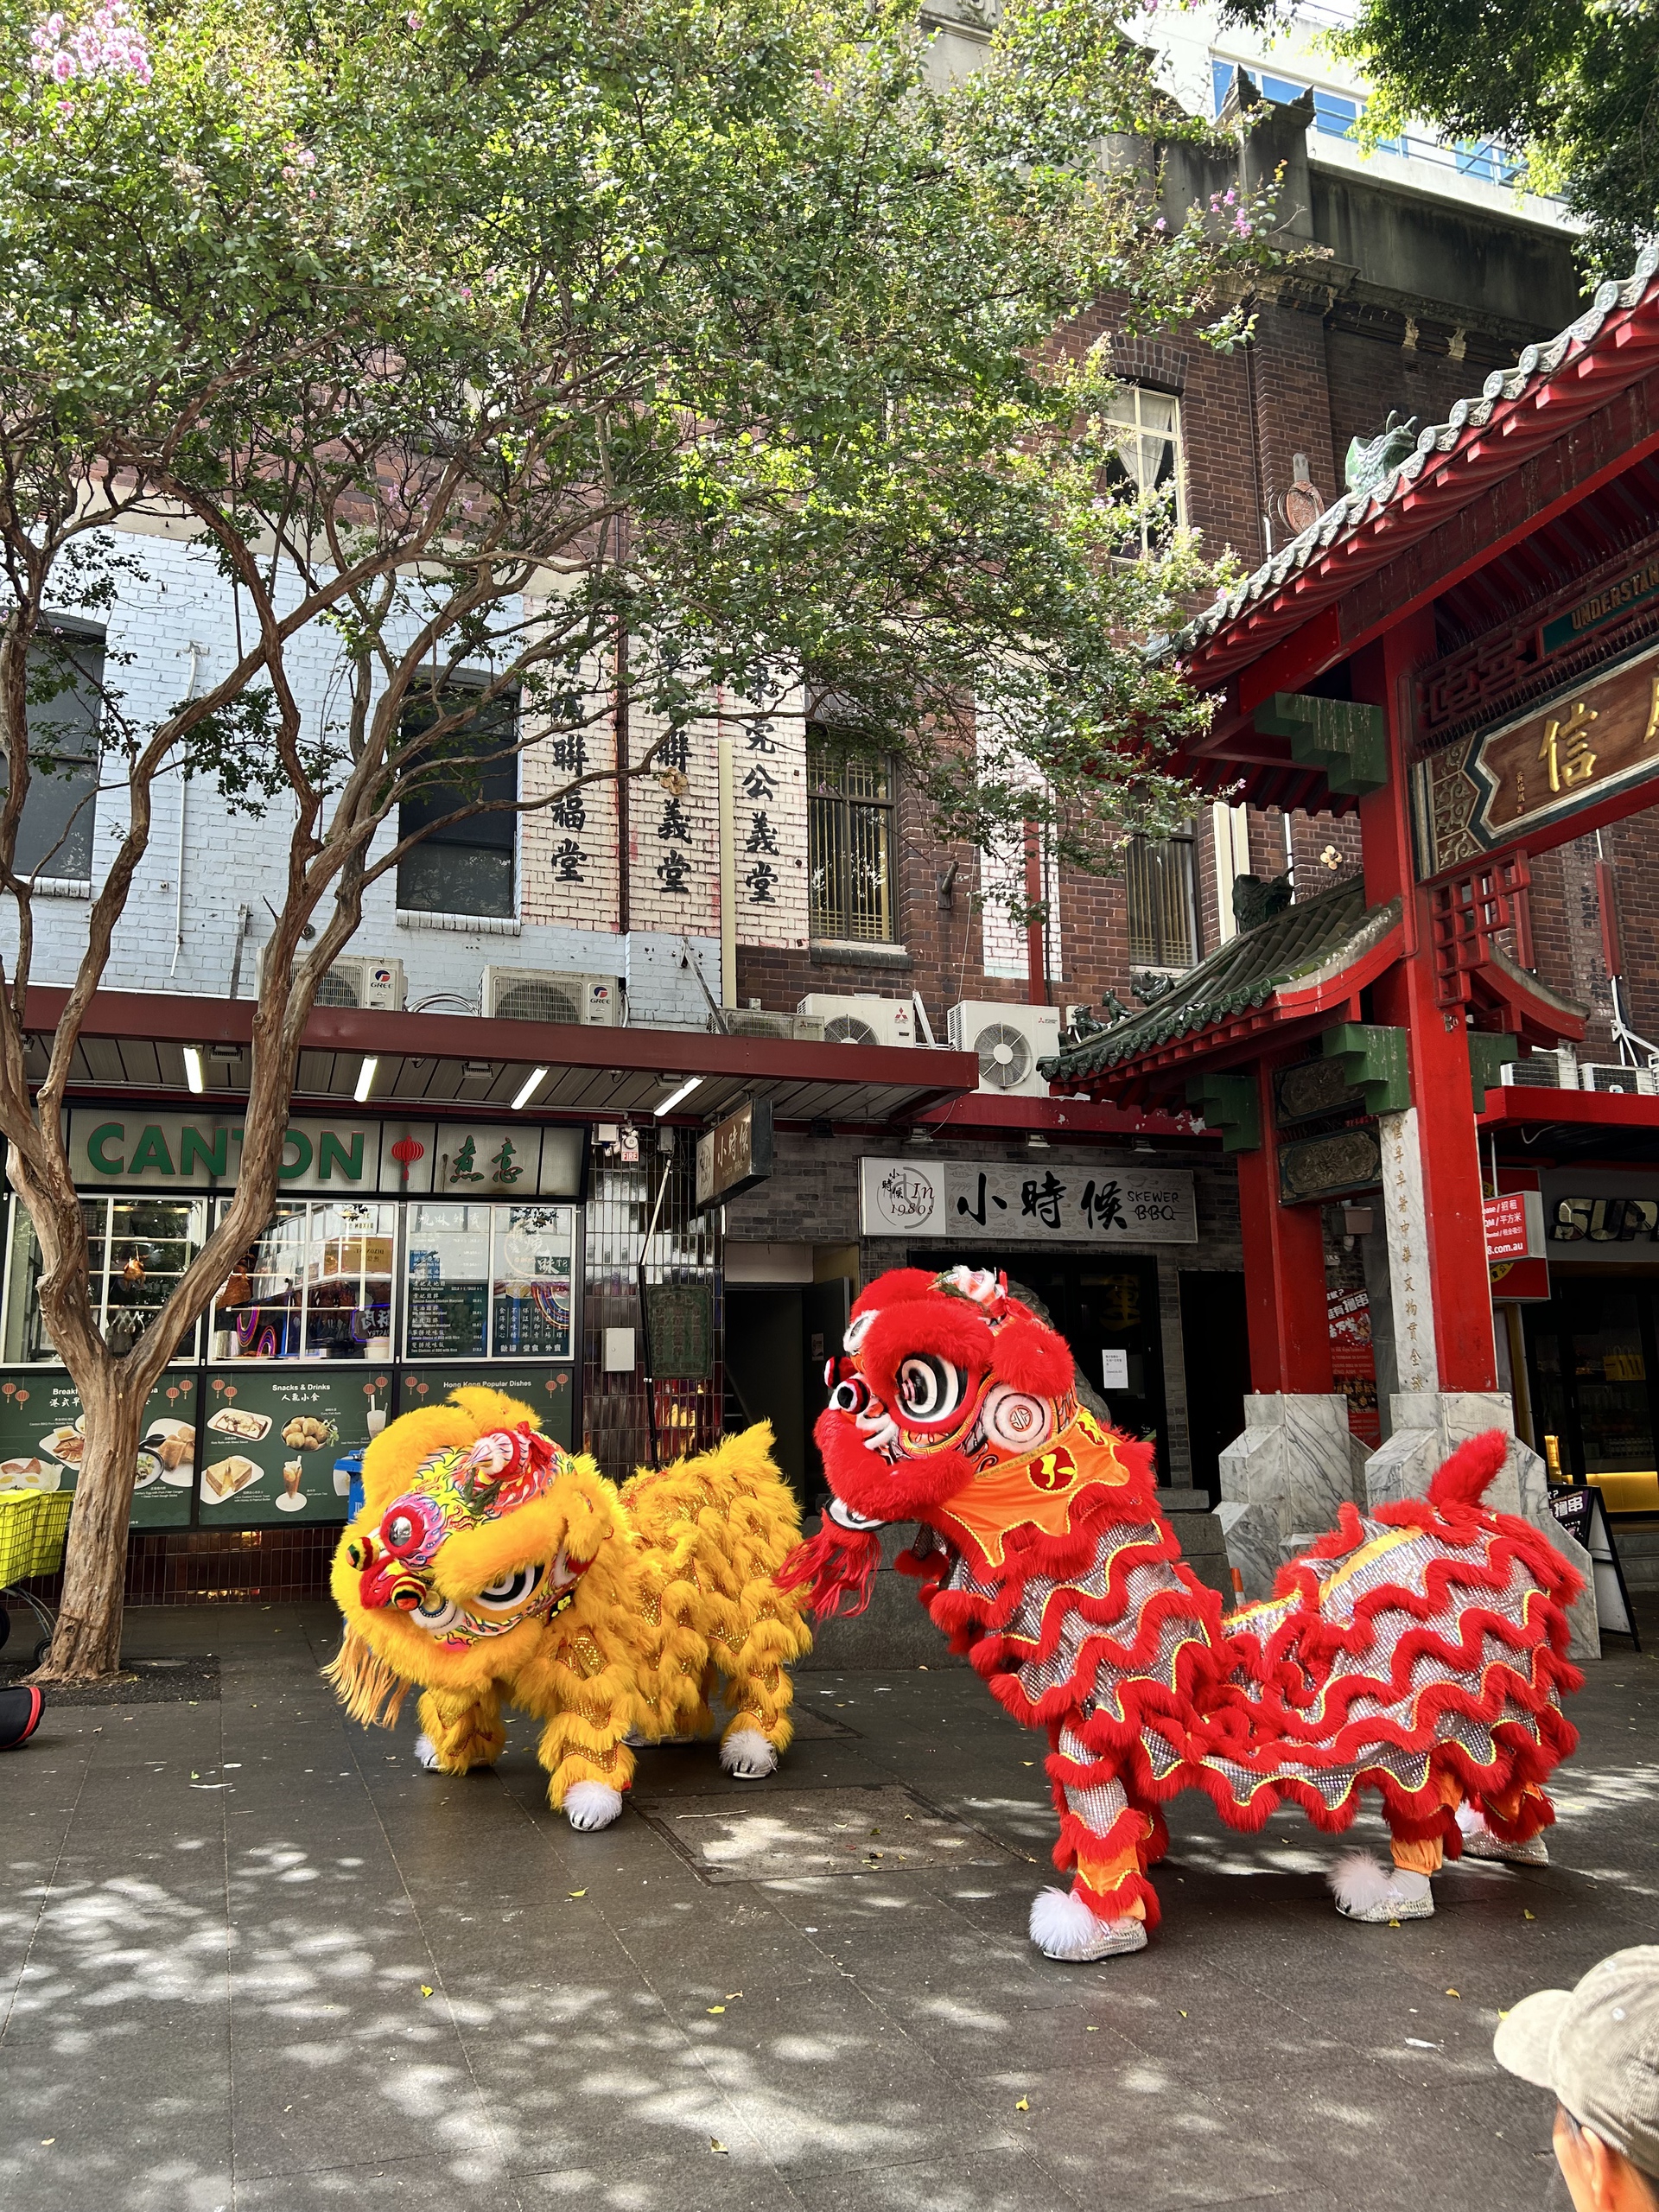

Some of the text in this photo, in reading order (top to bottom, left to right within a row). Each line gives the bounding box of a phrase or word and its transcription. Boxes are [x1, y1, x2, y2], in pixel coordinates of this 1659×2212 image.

[657, 645, 693, 894] 聯義堂
[87, 1122, 364, 1179] CANON
[718, 1123, 748, 1167] 小時候
[450, 1135, 523, 1184] 煮意
[623, 1152, 638, 1160] FIRE
[882, 1168, 903, 1199] 小時候
[912, 1183, 935, 1198] In
[957, 1171, 1128, 1230] 小時候
[1127, 1191, 1179, 1204] SKEWER
[891, 1203, 933, 1216] 1980s
[1135, 1205, 1177, 1221] BBQ
[1484, 1218, 1495, 1227] QM
[1500, 1212, 1522, 1224] 平方米
[1554, 1198, 1659, 1241] SUP
[1487, 1243, 1523, 1255] 8.com.au
[49, 1396, 80, 1408] 港式早
